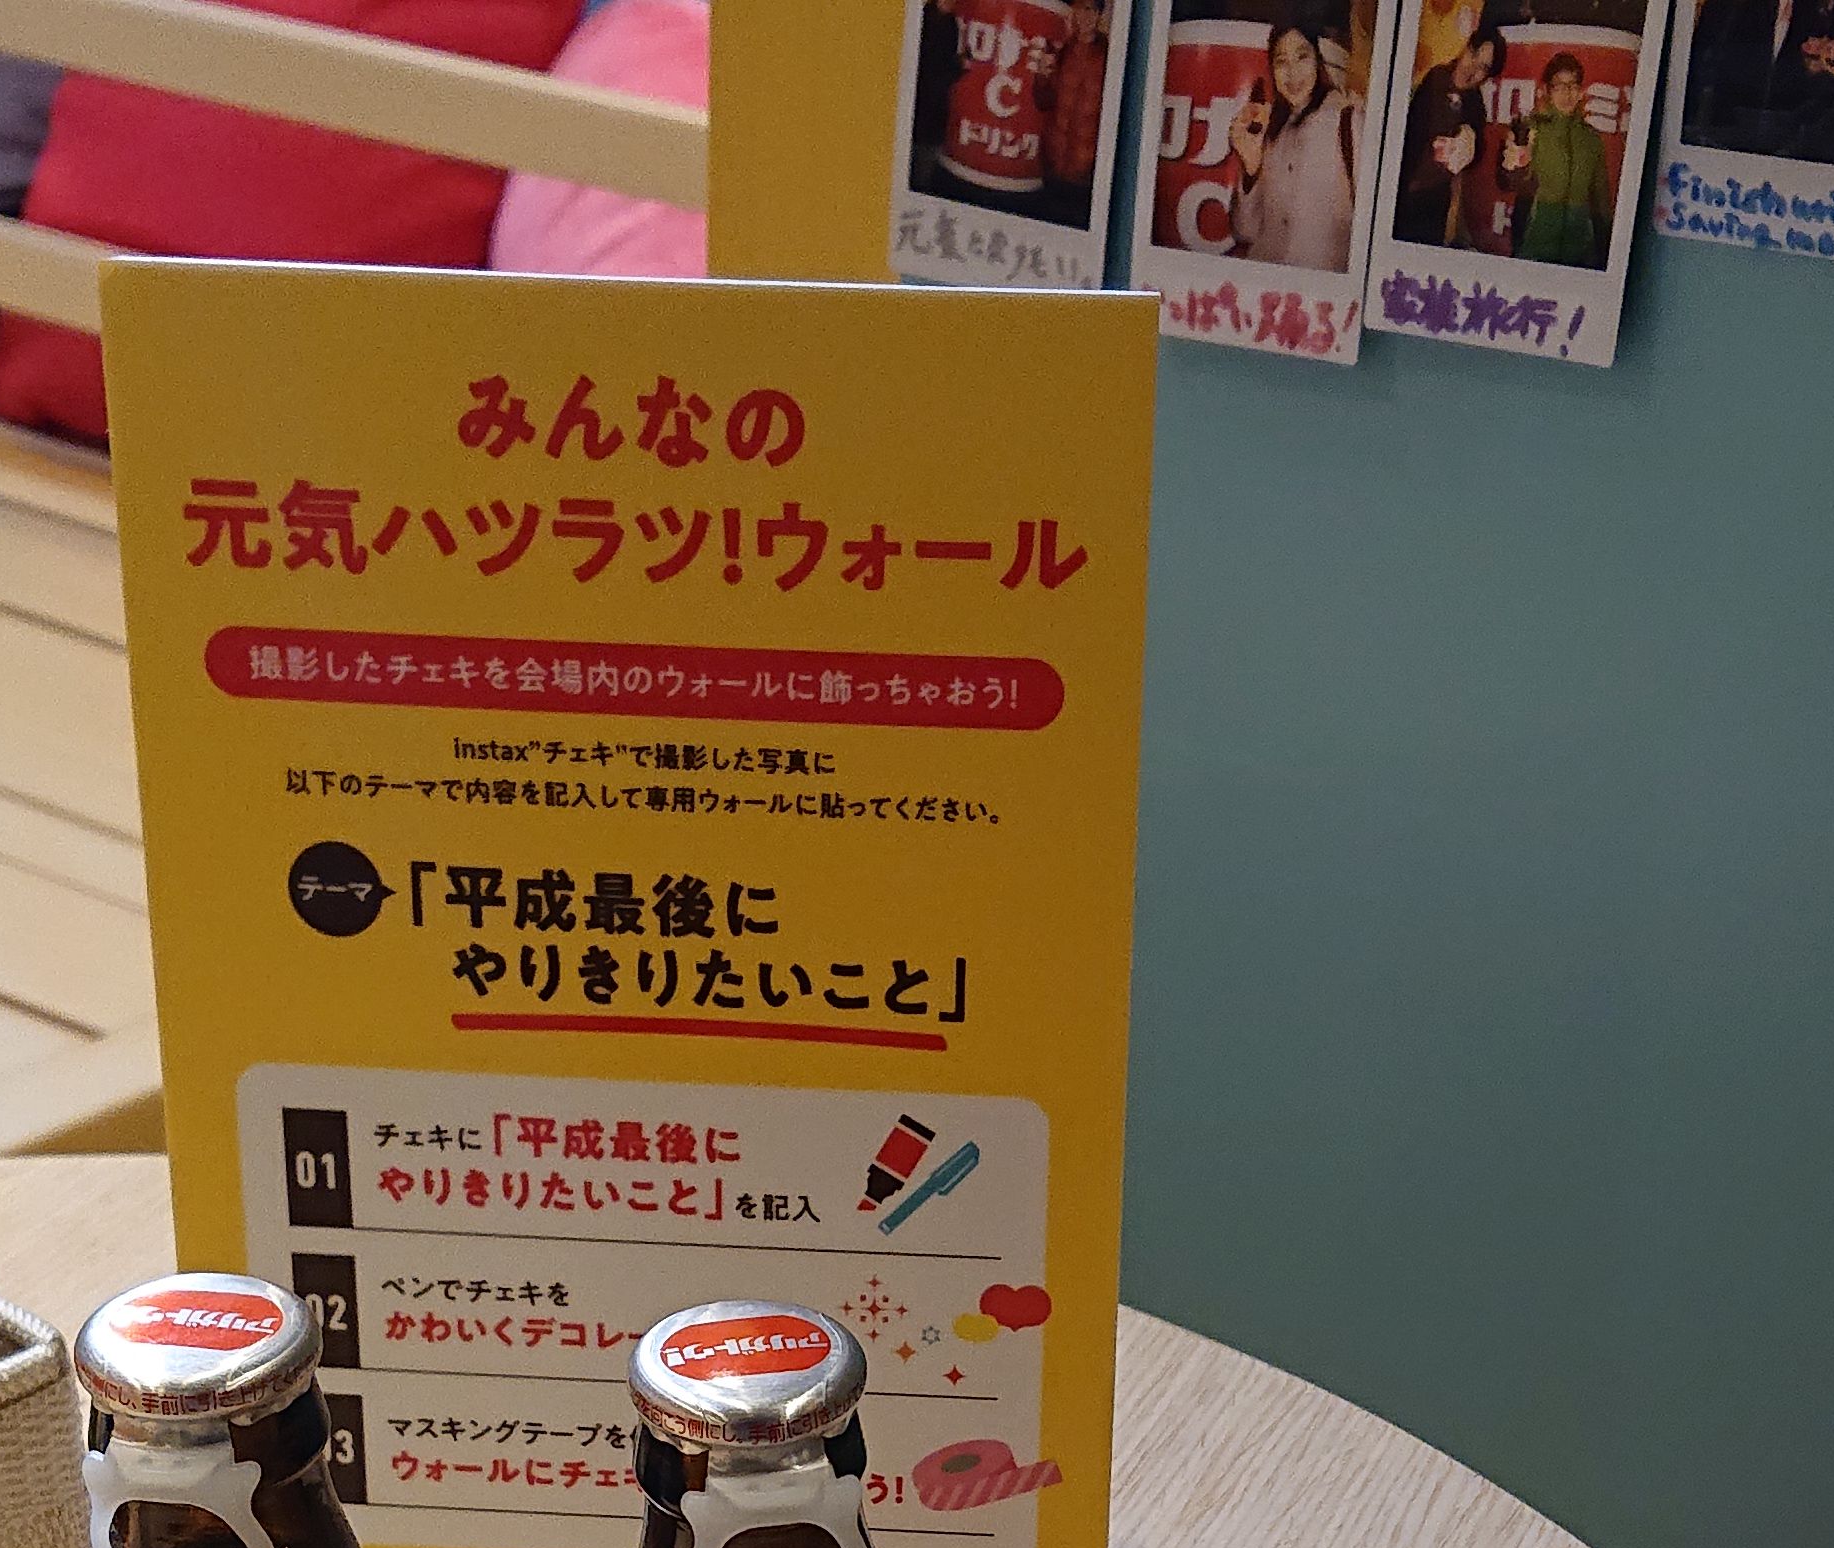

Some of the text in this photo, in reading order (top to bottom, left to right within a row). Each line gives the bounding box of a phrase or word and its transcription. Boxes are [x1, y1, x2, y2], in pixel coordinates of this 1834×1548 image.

[1140, 280, 1359, 354] っぱい踊る!
[457, 374, 807, 468] みんなの
[182, 478, 1090, 592] 元気ハツラツ!ウォール
[247, 642, 1020, 712] 撮影したチェキを会場内のウォールに飾っちゃおう!
[284, 767, 1003, 826] 以下のテーマで内容を記入して専用ウォールに貼ってください。
[295, 861, 781, 939] テーマ 「平成最後に
[451, 942, 966, 1024] やりきりたいこと」
[373, 1112, 742, 1164] チェキに「平成最後に
[295, 1151, 337, 1191] 01
[377, 1167, 822, 1224] やりきりたいこと」を記入
[381, 1277, 570, 1307] ペンでチェキを
[662, 1331, 829, 1367] アリガトウ!
